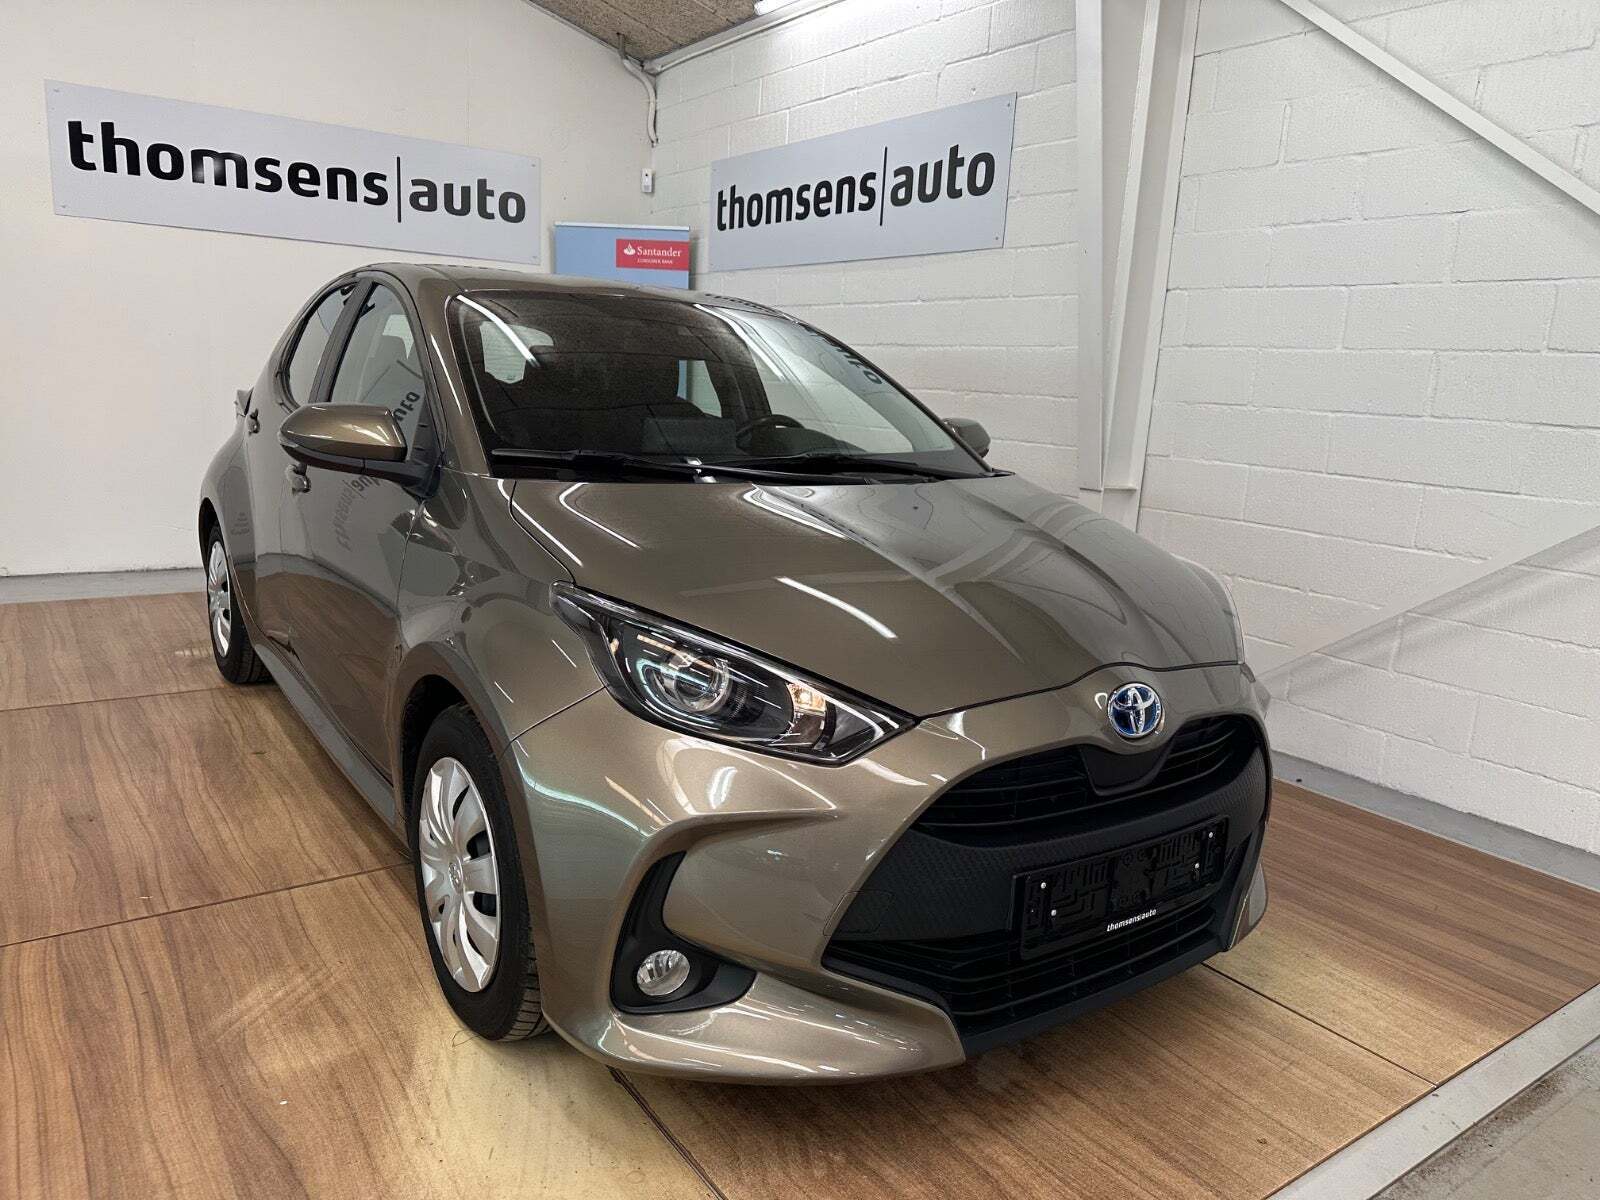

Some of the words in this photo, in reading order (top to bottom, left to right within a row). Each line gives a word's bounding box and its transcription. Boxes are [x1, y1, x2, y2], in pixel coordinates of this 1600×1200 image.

[67, 120, 390, 206] thomsens
[409, 178, 527, 224] auto
[716, 171, 878, 232] thomsens
[890, 144, 996, 207] auto
[637, 246, 682, 257] Santander
